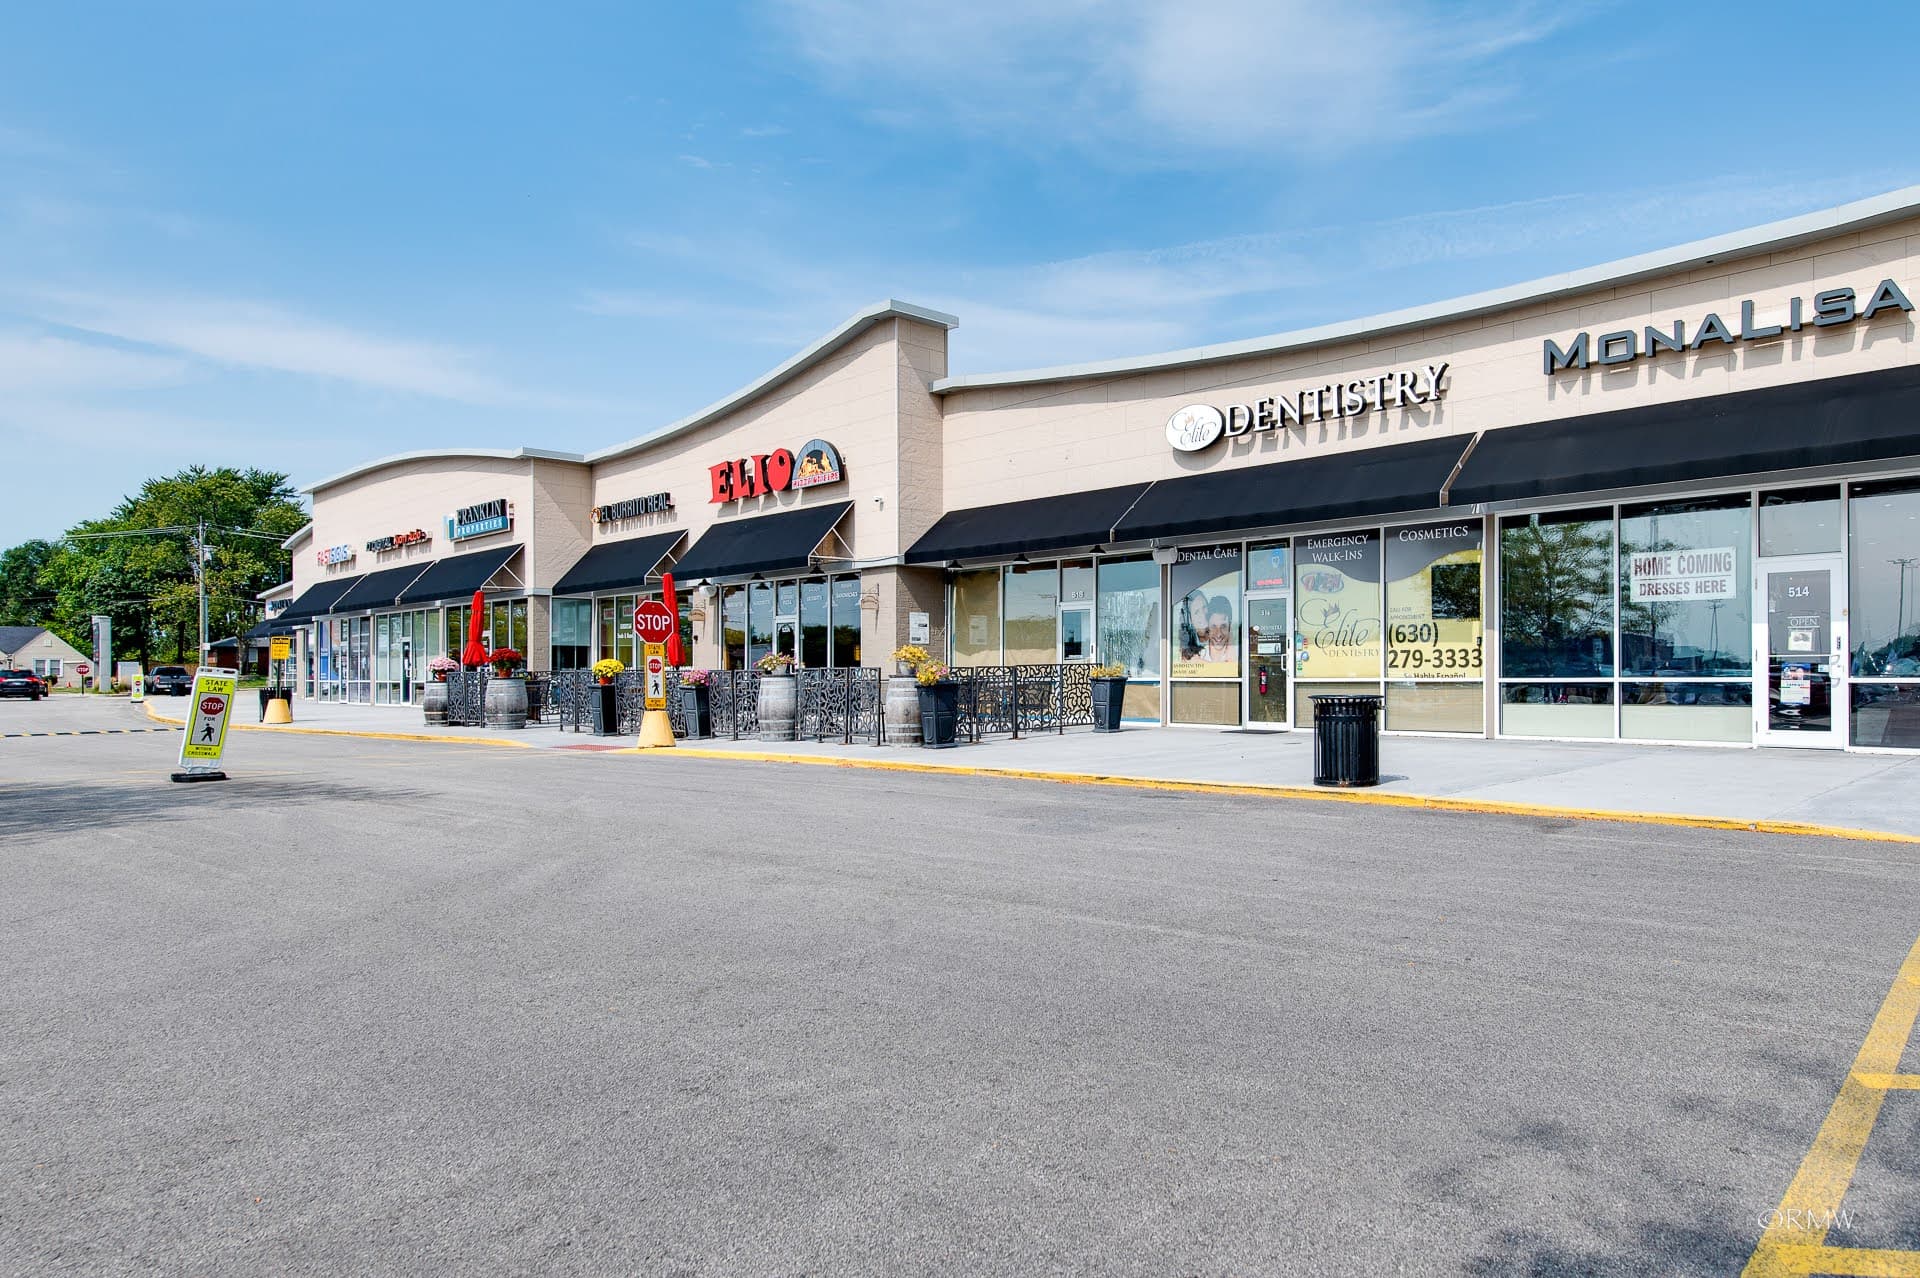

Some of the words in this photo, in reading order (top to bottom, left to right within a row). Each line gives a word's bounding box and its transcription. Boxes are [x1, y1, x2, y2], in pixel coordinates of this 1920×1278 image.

[1544, 278, 1915, 376] MONALISA
[1172, 410, 1217, 446] Elite
[1223, 362, 1448, 437] DENTISTRY
[708, 448, 792, 504] ELIO
[456, 499, 502, 525] FRANKLIN
[601, 505, 611, 522] EL
[612, 497, 646, 520] BURRITO
[647, 492, 669, 513] REAL
[457, 518, 503, 537] PROPERTIES
[1400, 526, 1469, 541] COSMETICS
[1307, 535, 1369, 550] EMERGENCY
[1178, 550, 1212, 562] DENTAL
[1213, 547, 1238, 559] CARE
[1312, 550, 1363, 563] WALK-INS
[1633, 556, 1672, 577] HOME
[1677, 551, 1732, 575] COMING
[1639, 582, 1690, 597] DRESSES
[1695, 579, 1727, 594] HERE
[1787, 585, 1811, 598] 514
[636, 613, 671, 631] STOP
[1300, 598, 1381, 649] Elite
[1790, 617, 1818, 626] OPEN
[1388, 622, 1439, 648] (630)
[1328, 647, 1380, 658] DENTISTRY
[1388, 648, 1483, 669] 279-3333
[205, 679, 228, 687] STATE
[201, 701, 224, 710] STOP
